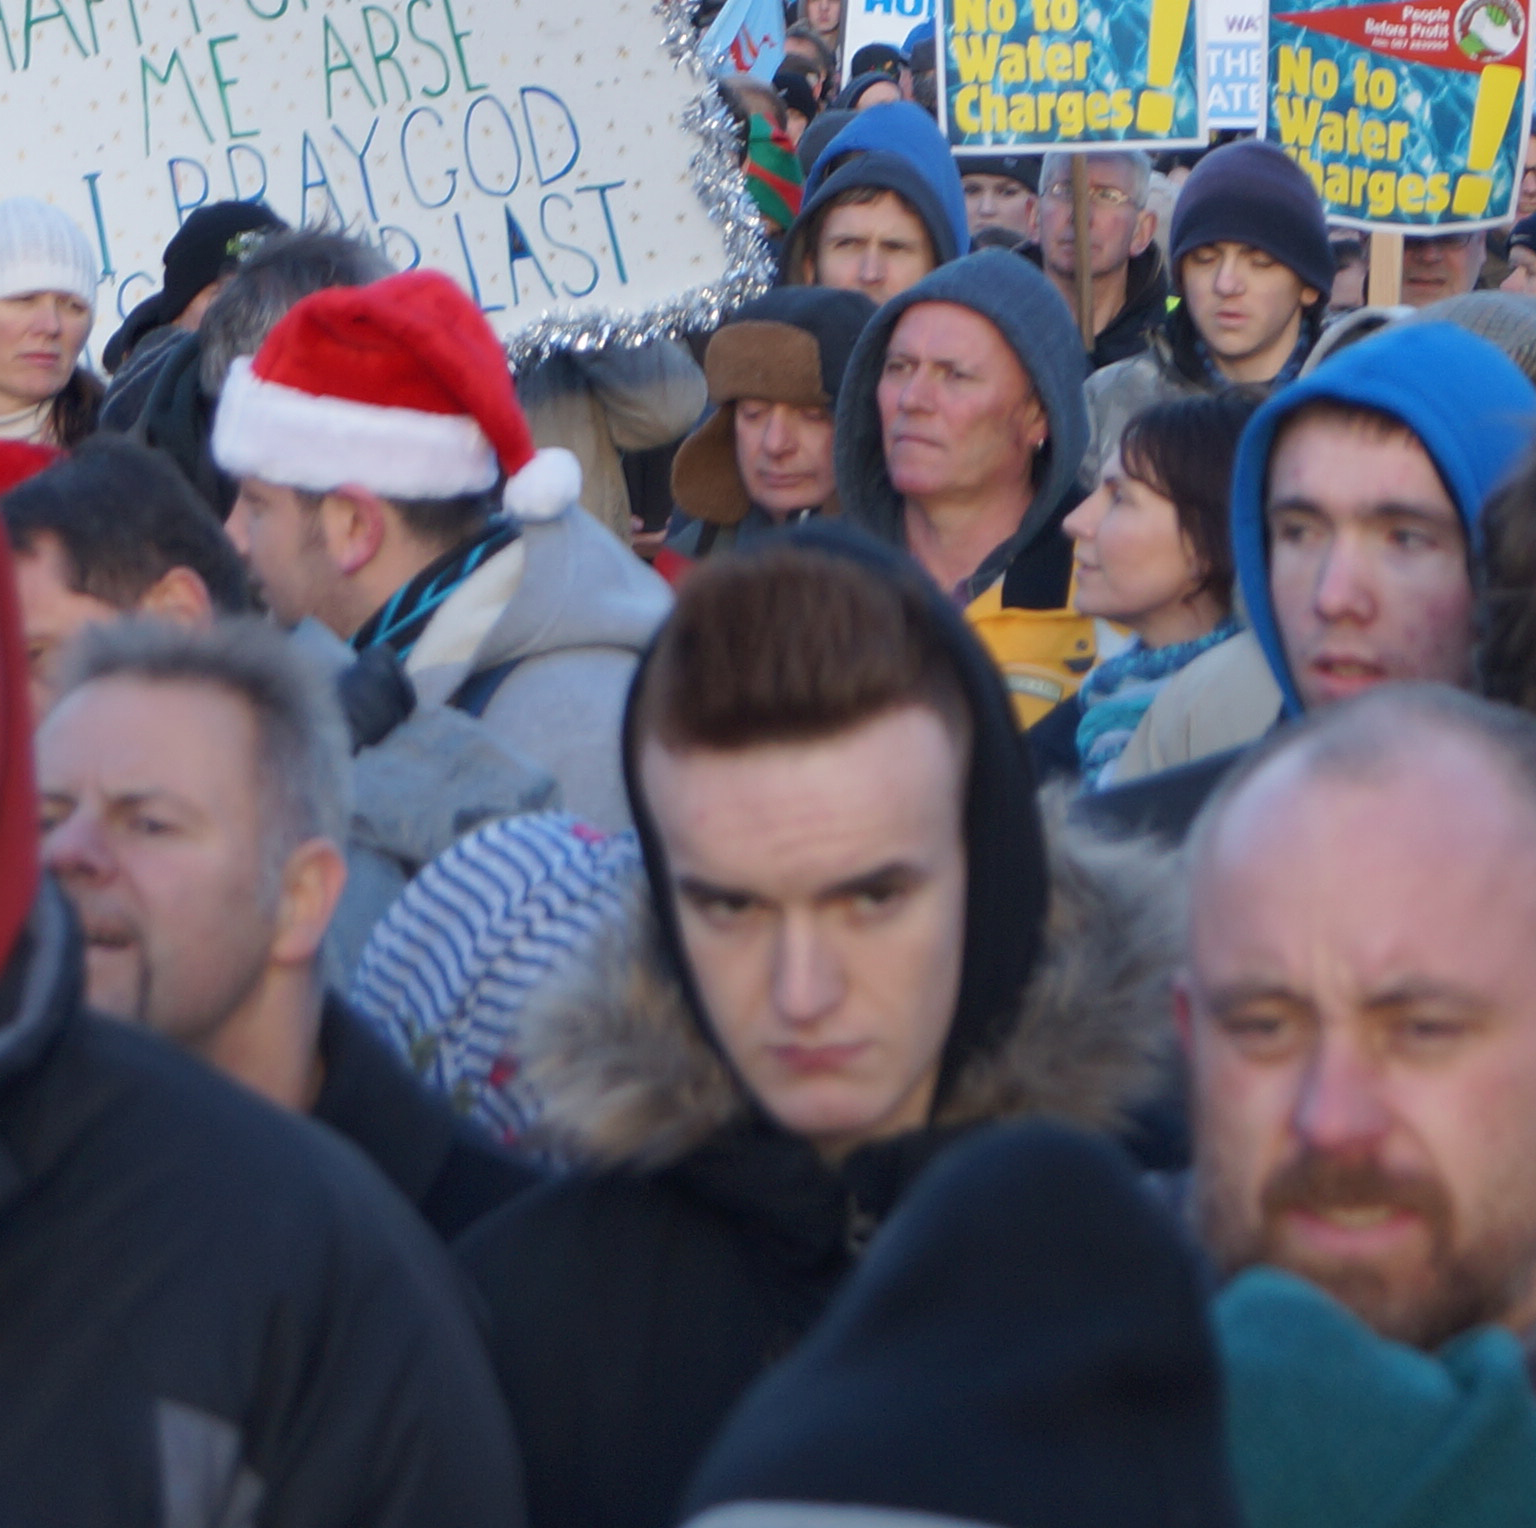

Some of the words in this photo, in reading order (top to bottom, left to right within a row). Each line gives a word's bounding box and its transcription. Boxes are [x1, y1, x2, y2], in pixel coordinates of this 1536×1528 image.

[1364, 16, 1408, 37] Before
[1410, 21, 1450, 40] Profit
[1402, 4, 1451, 24] People
[953, 34, 1093, 84] Water
[1277, 43, 1340, 102] No
[1353, 56, 1398, 110] to
[138, 32, 262, 159] ME
[1274, 94, 1410, 163] Water
[82, 171, 117, 285] I
[400, 84, 582, 210] GOD
[1302, 148, 1452, 218] harges
[453, 179, 630, 314] LAST
